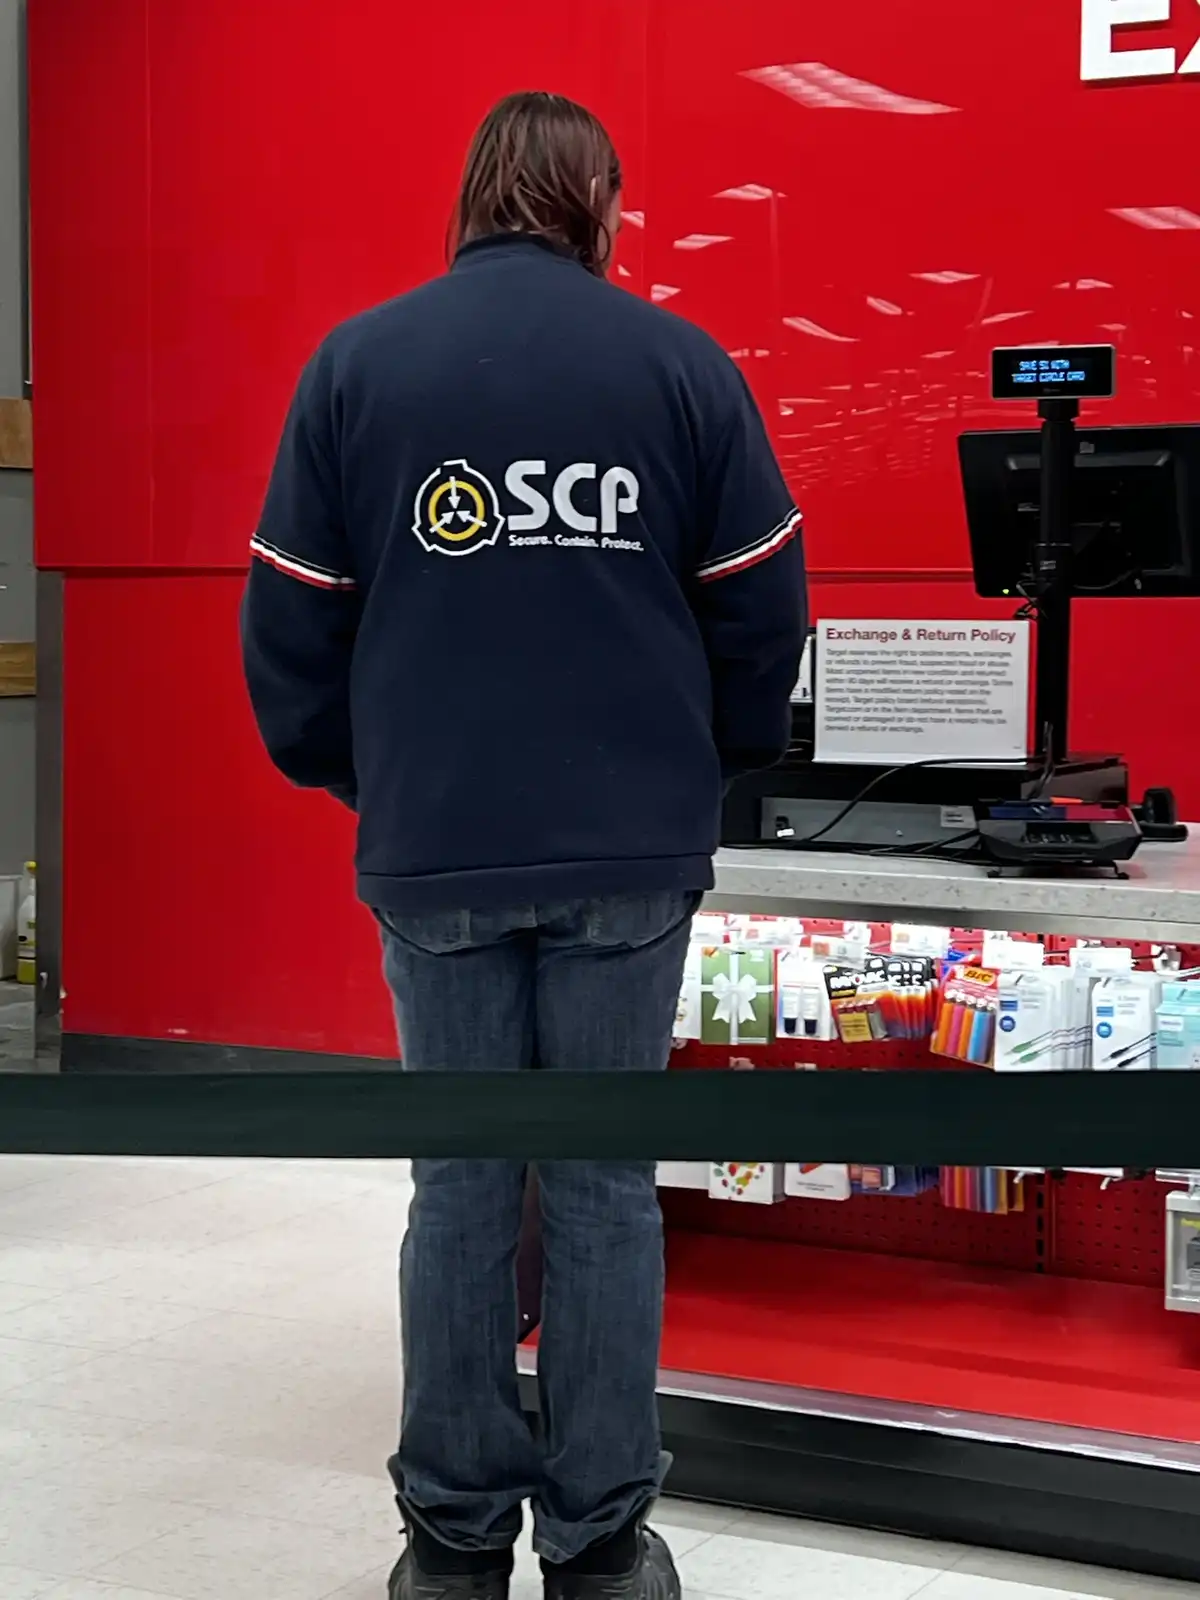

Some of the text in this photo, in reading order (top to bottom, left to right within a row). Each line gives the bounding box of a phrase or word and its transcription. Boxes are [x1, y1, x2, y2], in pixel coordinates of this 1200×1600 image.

[1080, 0, 1200, 81] E
[504, 460, 639, 533] SCP
[508, 535, 553, 546] Secure.
[826, 628, 1016, 644] Exchange & Return Policy
[964, 970, 993, 982] BIC
